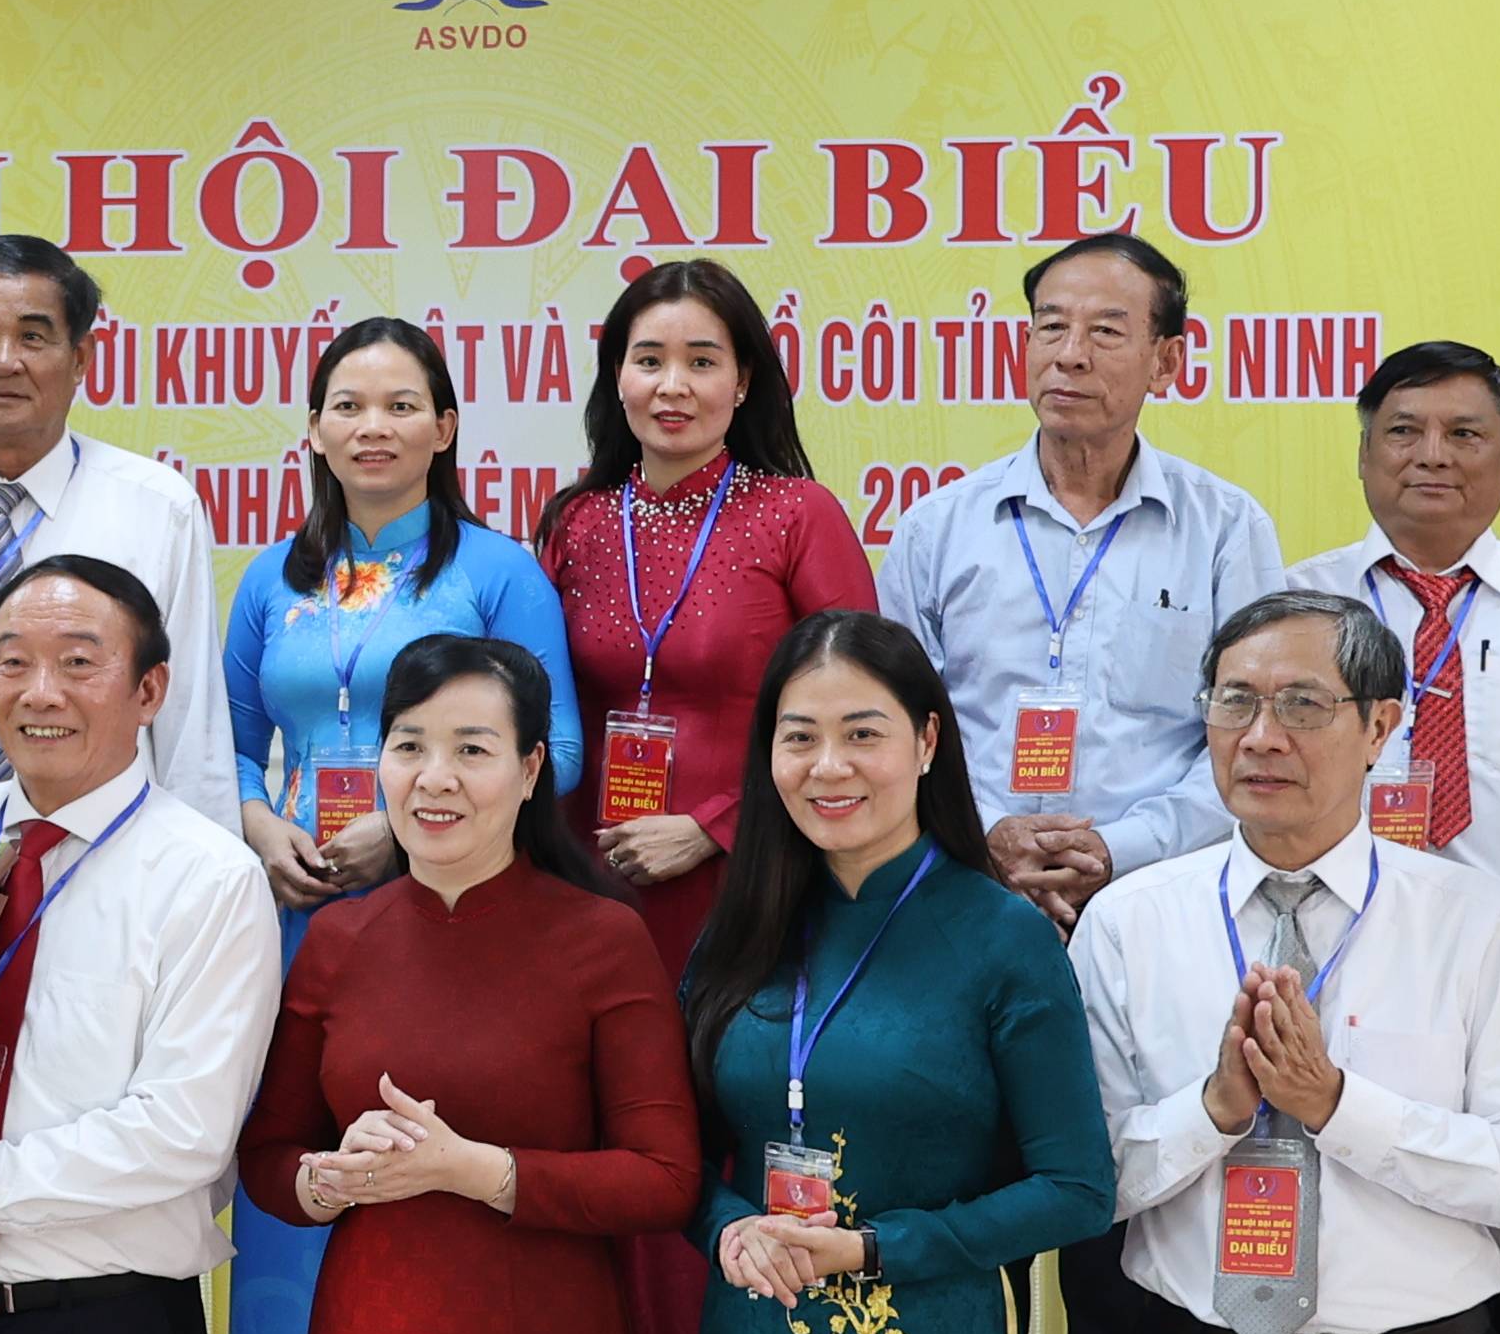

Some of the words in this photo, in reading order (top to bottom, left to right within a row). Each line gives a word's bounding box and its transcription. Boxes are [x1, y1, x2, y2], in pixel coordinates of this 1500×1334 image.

[415, 23, 528, 51] ASVDO
[58, 119, 397, 289] HỘI
[447, 141, 768, 289] ĐẠI
[821, 72, 1278, 244] BIỂU
[501, 307, 573, 403] VÀ
[820, 304, 917, 403] CÔI
[935, 292, 1028, 401] TỈN
[1229, 317, 1377, 399] NINH
